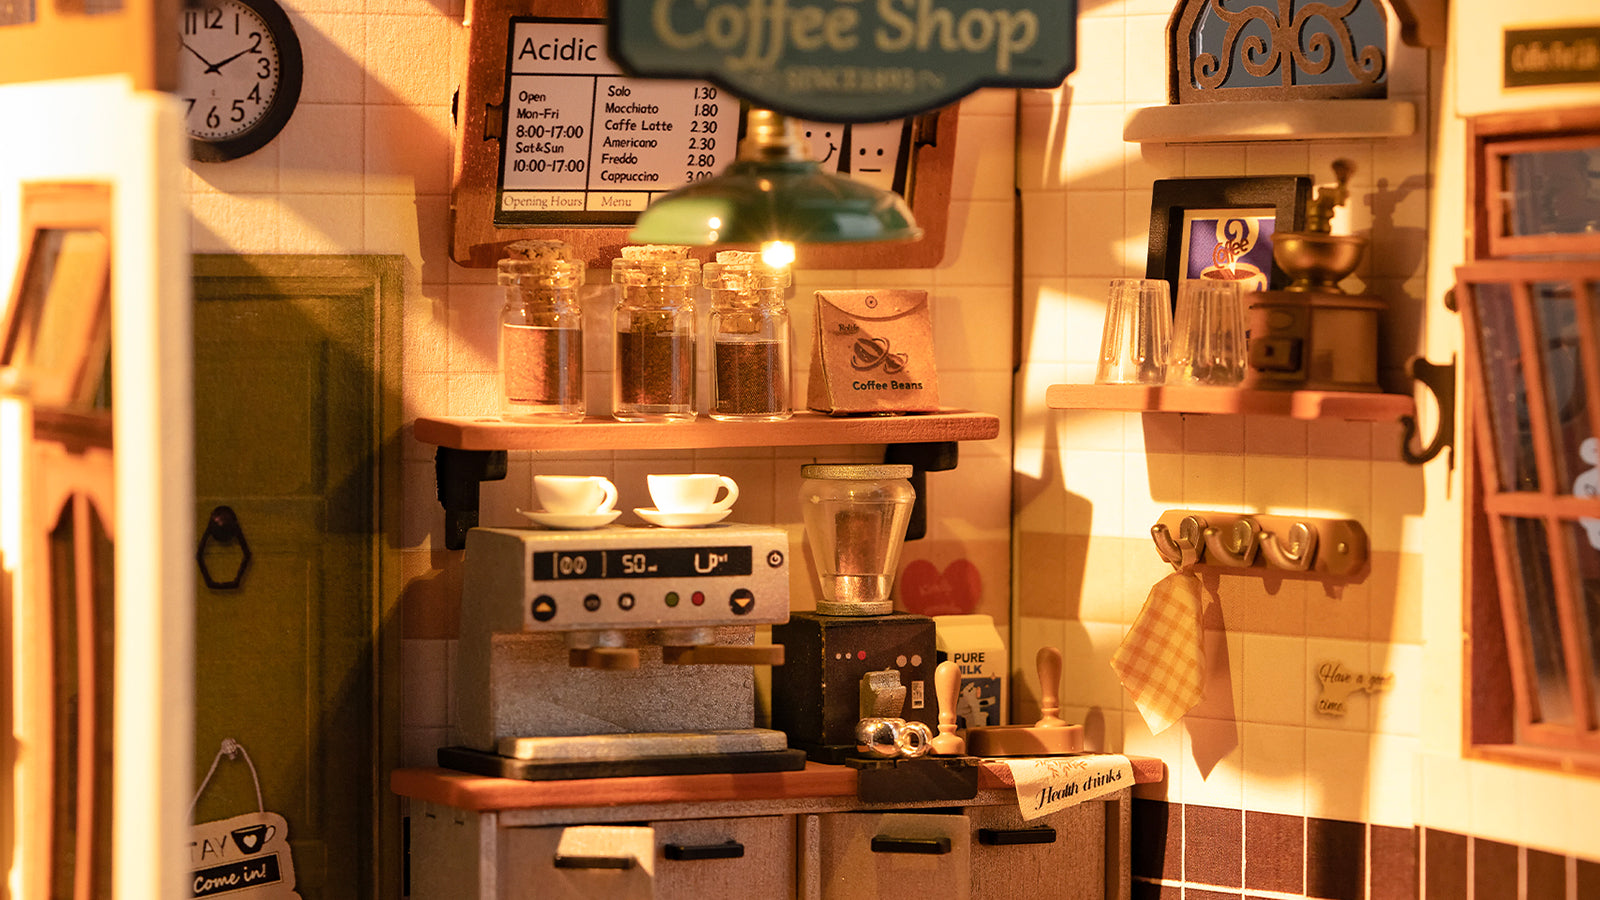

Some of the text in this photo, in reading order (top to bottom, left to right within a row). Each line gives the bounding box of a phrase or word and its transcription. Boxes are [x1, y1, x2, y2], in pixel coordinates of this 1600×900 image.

[204, 7, 223, 29] 12
[249, 32, 262, 54] 2
[652, 0, 1039, 73] Coffee Shop
[518, 37, 598, 61] Acidic
[257, 57, 270, 79] 3
[247, 82, 261, 104] 4
[519, 91, 546, 103] Open
[607, 85, 631, 97] Solo
[694, 87, 717, 101] 1.30
[230, 100, 245, 122] 5
[516, 108, 559, 120] Mon-Fri
[605, 103, 659, 114] Macchiato
[694, 104, 718, 117] 1.80
[206, 105, 220, 128] 6
[516, 125, 584, 139] 8:00-17:00
[605, 119, 673, 132] Caffe Latte
[690, 121, 718, 134] 2.30
[515, 142, 564, 154] Sat&Sun
[603, 137, 658, 148] Americano
[688, 138, 716, 151] 2.30
[601, 153, 638, 165] Freddo
[687, 154, 715, 167] 2.80
[513, 159, 585, 173] 10:00-17:00
[600, 170, 659, 183] Cappuccino
[503, 195, 583, 209] Opening Hours
[601, 196, 632, 207] Menu
[1212, 238, 1249, 269] Coffee
[852, 380, 923, 391] Coffee Beans
[954, 652, 985, 663] PURE
[1319, 663, 1351, 683] Have
[1035, 769, 1122, 810] Health drinks
[193, 863, 267, 893] Come in!
